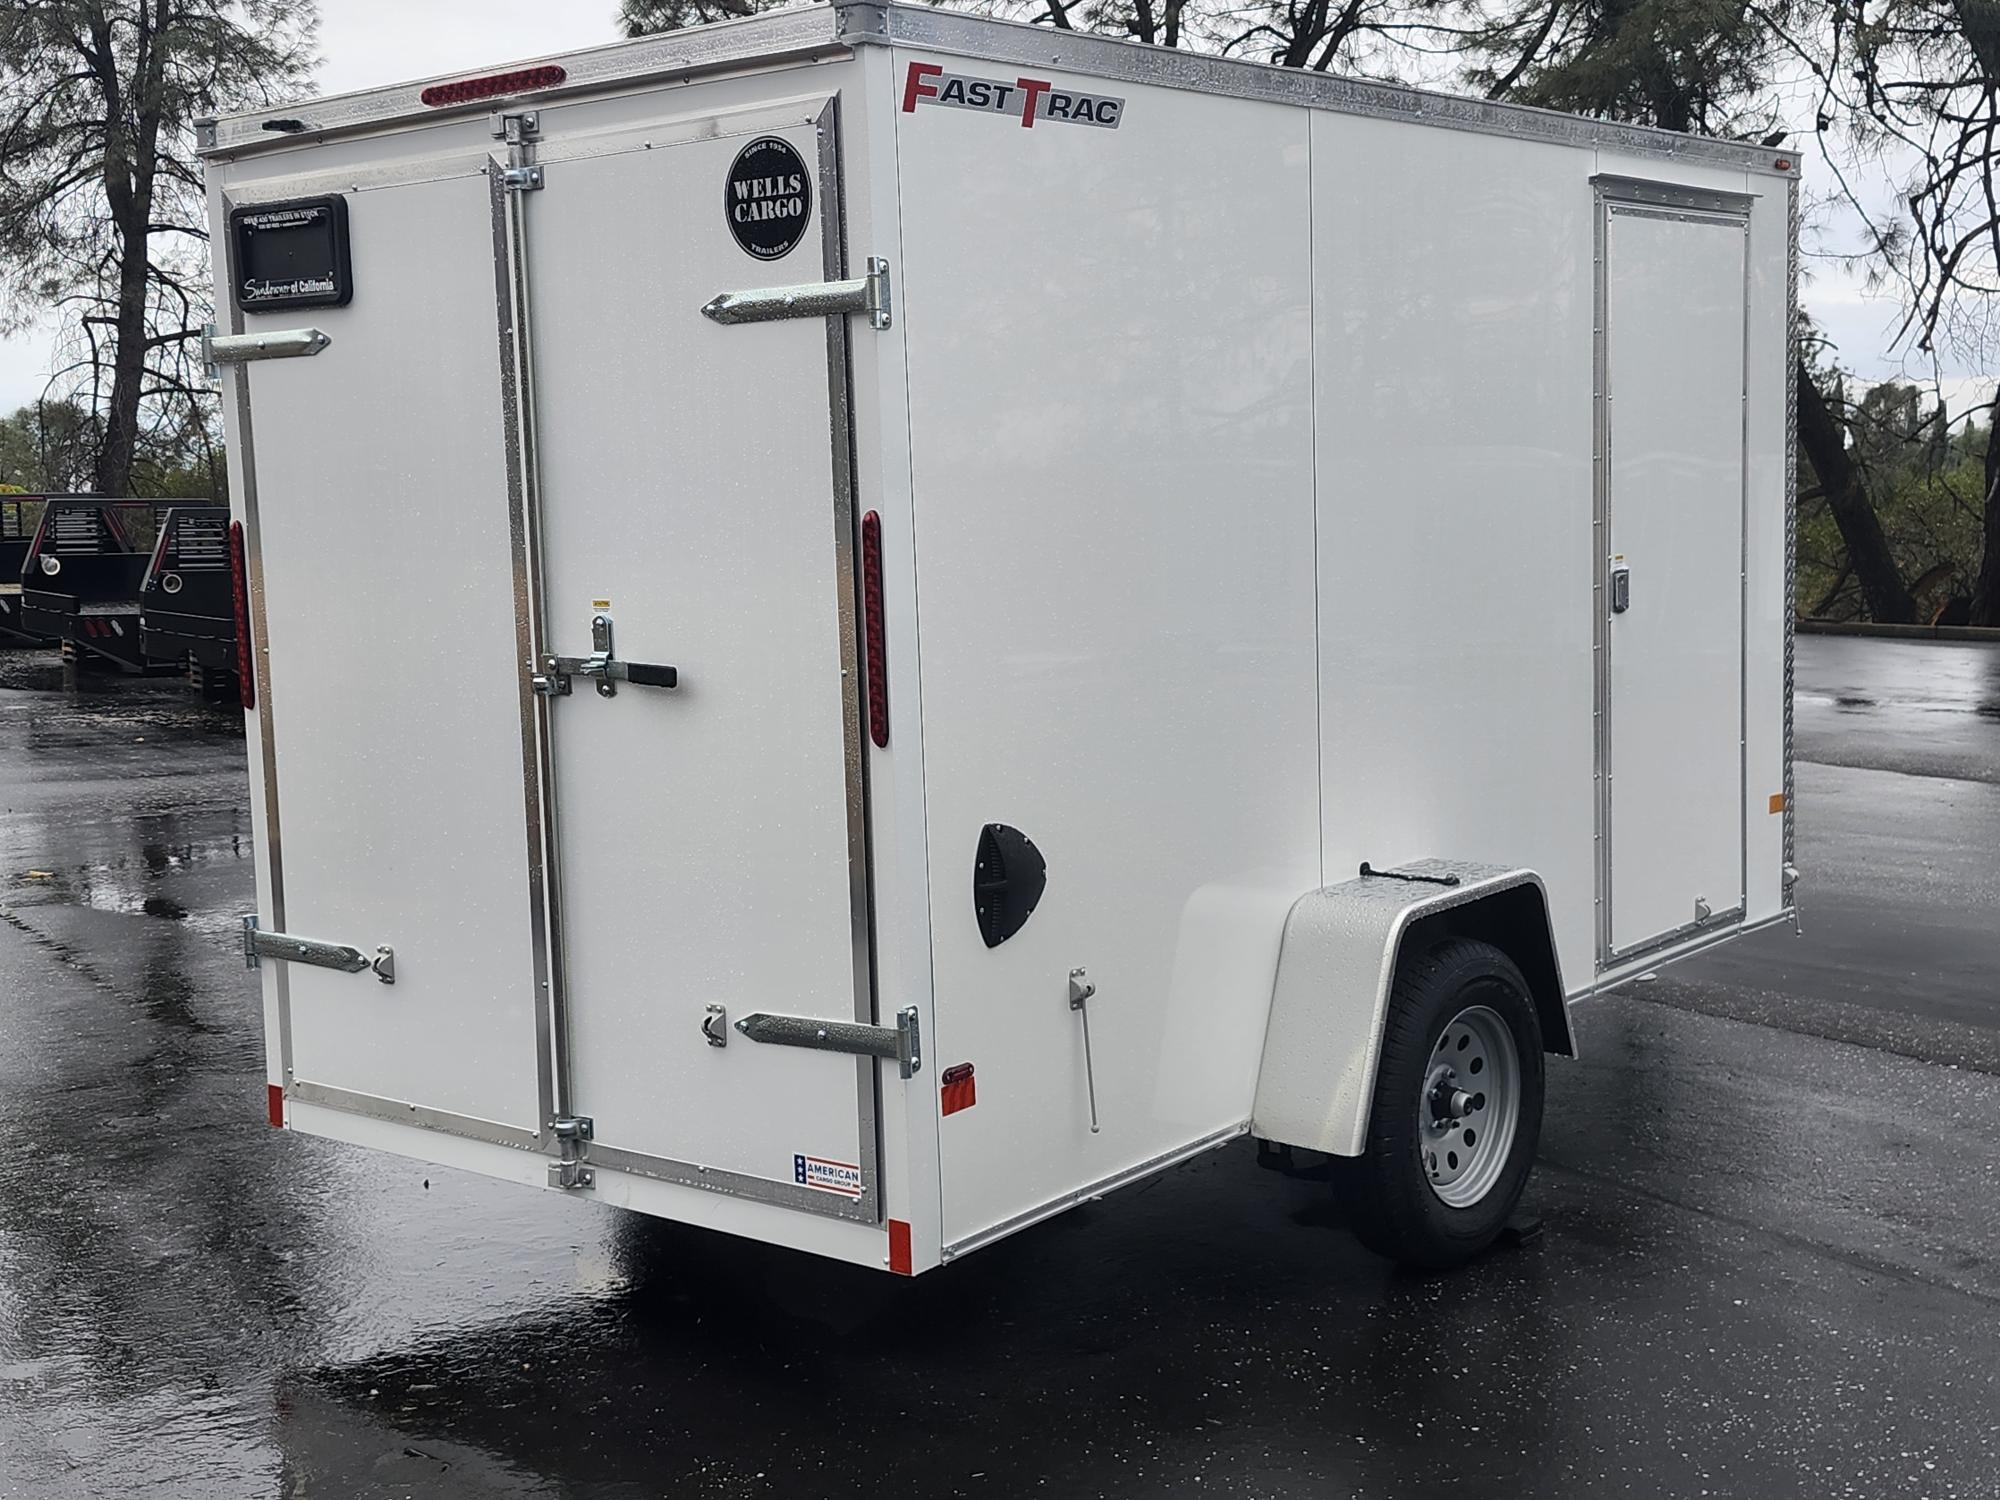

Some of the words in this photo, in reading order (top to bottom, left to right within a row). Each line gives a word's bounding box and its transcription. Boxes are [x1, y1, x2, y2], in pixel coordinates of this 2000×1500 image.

[744, 142, 767, 159] SINCE
[733, 173, 802, 200] WELLS
[734, 197, 802, 223] CARGO
[751, 240, 789, 255] TRAILERS
[299, 278, 334, 292] California
[807, 1164, 859, 1182] AMERICAN
[816, 1176, 833, 1184] CARGO
[833, 1179, 851, 1187] GROUP
